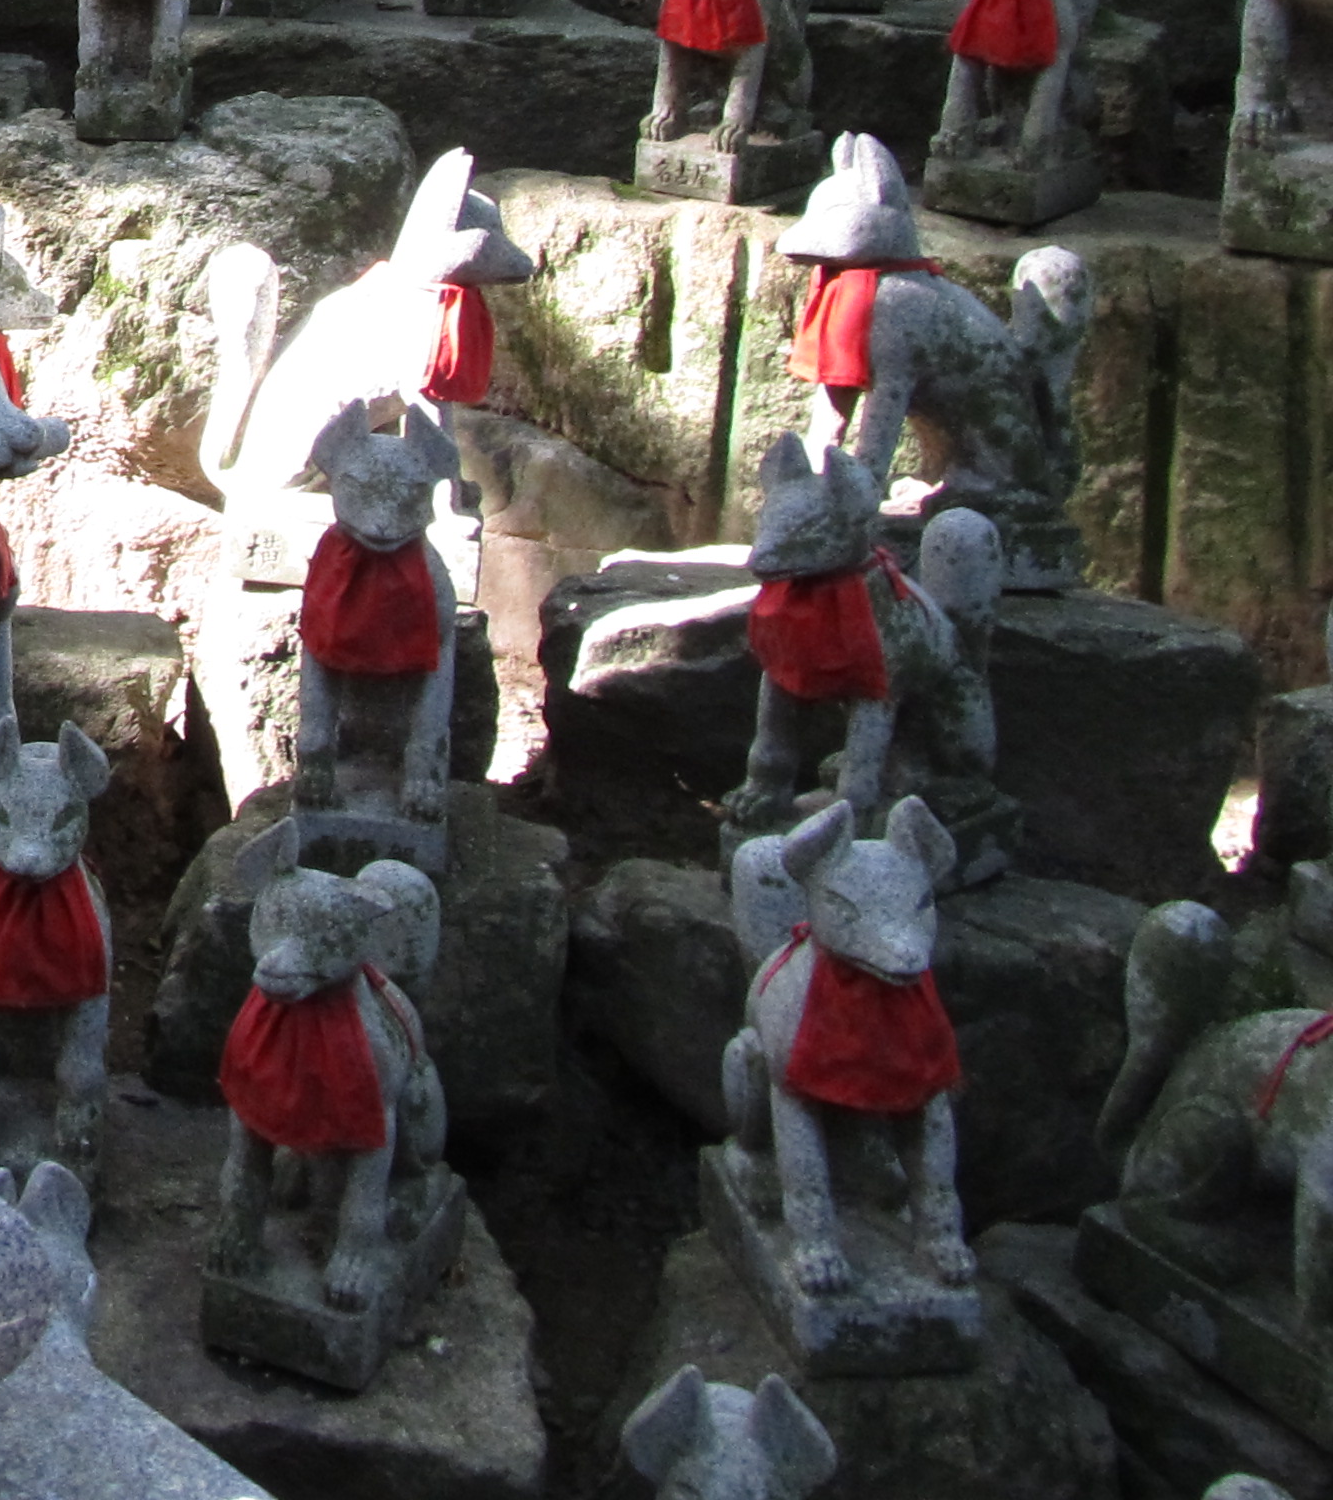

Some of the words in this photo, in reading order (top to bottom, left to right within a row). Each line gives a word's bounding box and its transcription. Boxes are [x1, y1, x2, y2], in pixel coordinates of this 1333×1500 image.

[652, 159, 712, 189] 名古屋
[246, 533, 284, 577] 横
